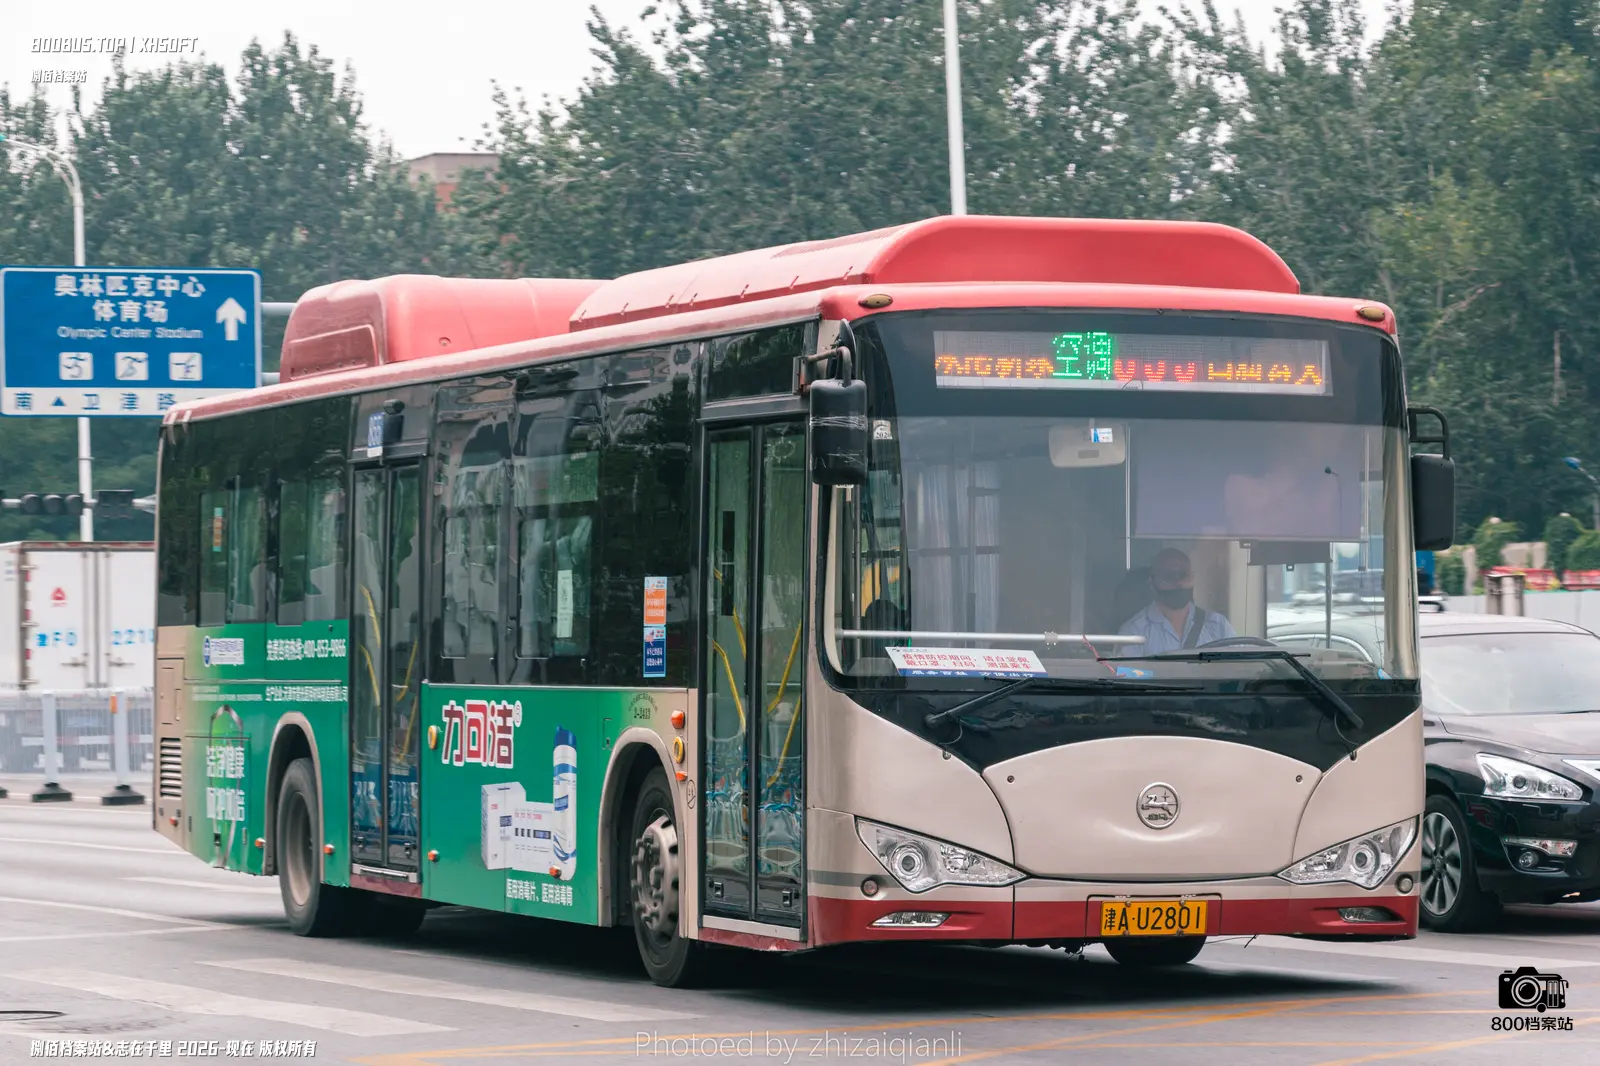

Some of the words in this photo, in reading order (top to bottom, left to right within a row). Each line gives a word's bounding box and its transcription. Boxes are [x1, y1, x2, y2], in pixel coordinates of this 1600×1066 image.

[54, 274, 206, 297] 奥林匹克中心
[92, 299, 168, 323] 体育场
[57, 326, 107, 339] Olympic
[111, 326, 152, 338] Center
[155, 326, 203, 339] Stadium
